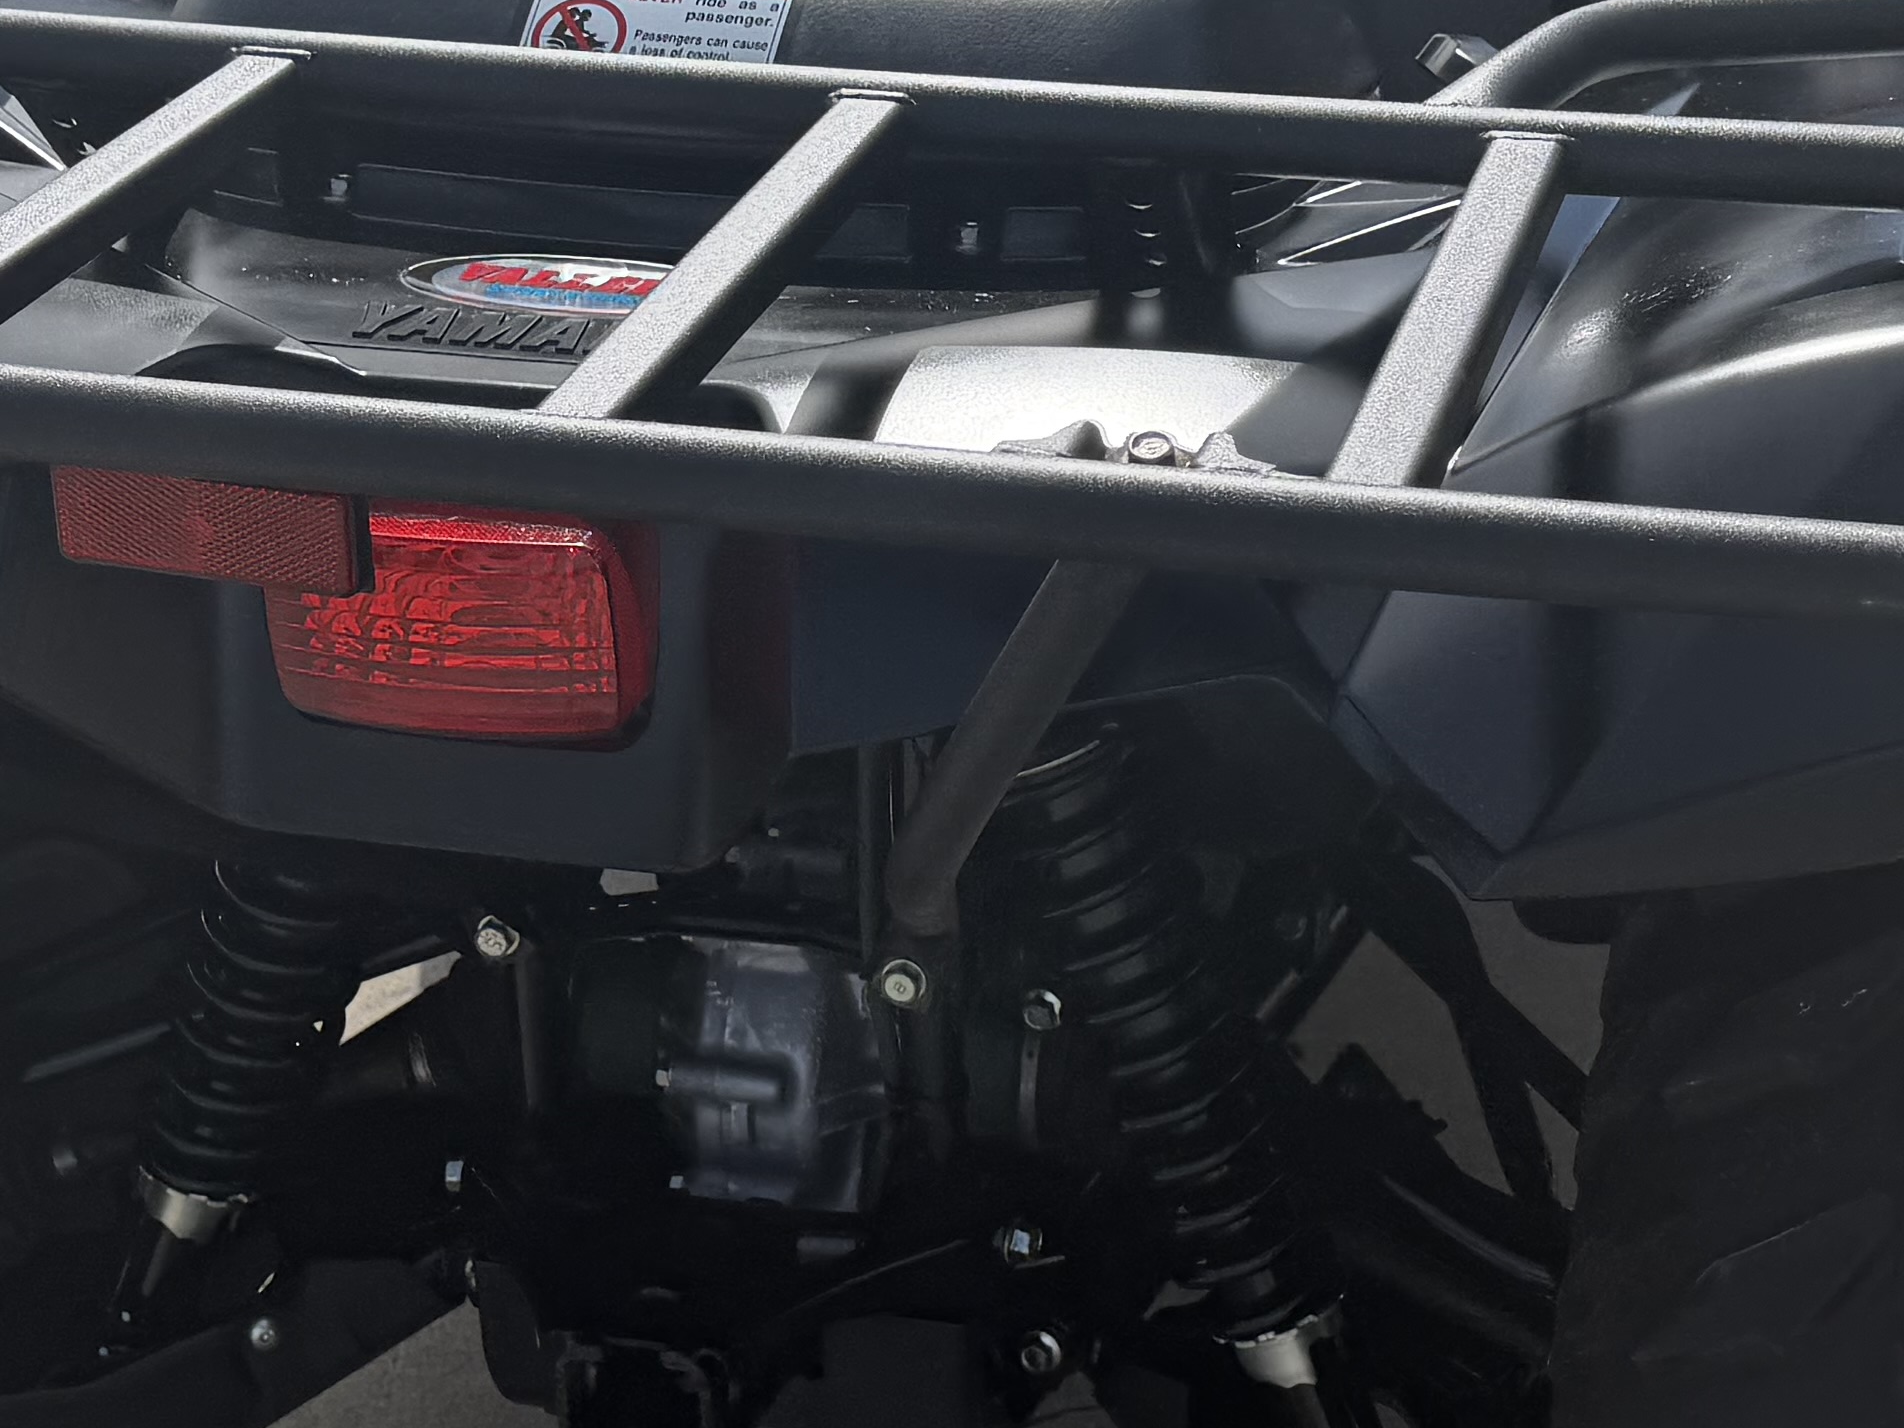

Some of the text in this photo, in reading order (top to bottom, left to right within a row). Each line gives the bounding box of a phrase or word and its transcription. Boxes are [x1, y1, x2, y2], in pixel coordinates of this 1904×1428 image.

[739, 0, 757, 11] as
[769, 2, 779, 12] a
[685, 10, 774, 28] passenger.
[633, 28, 769, 51] Passengers can cause
[641, 44, 665, 57] loss
[670, 47, 682, 59] of
[352, 300, 612, 355] YAMA
